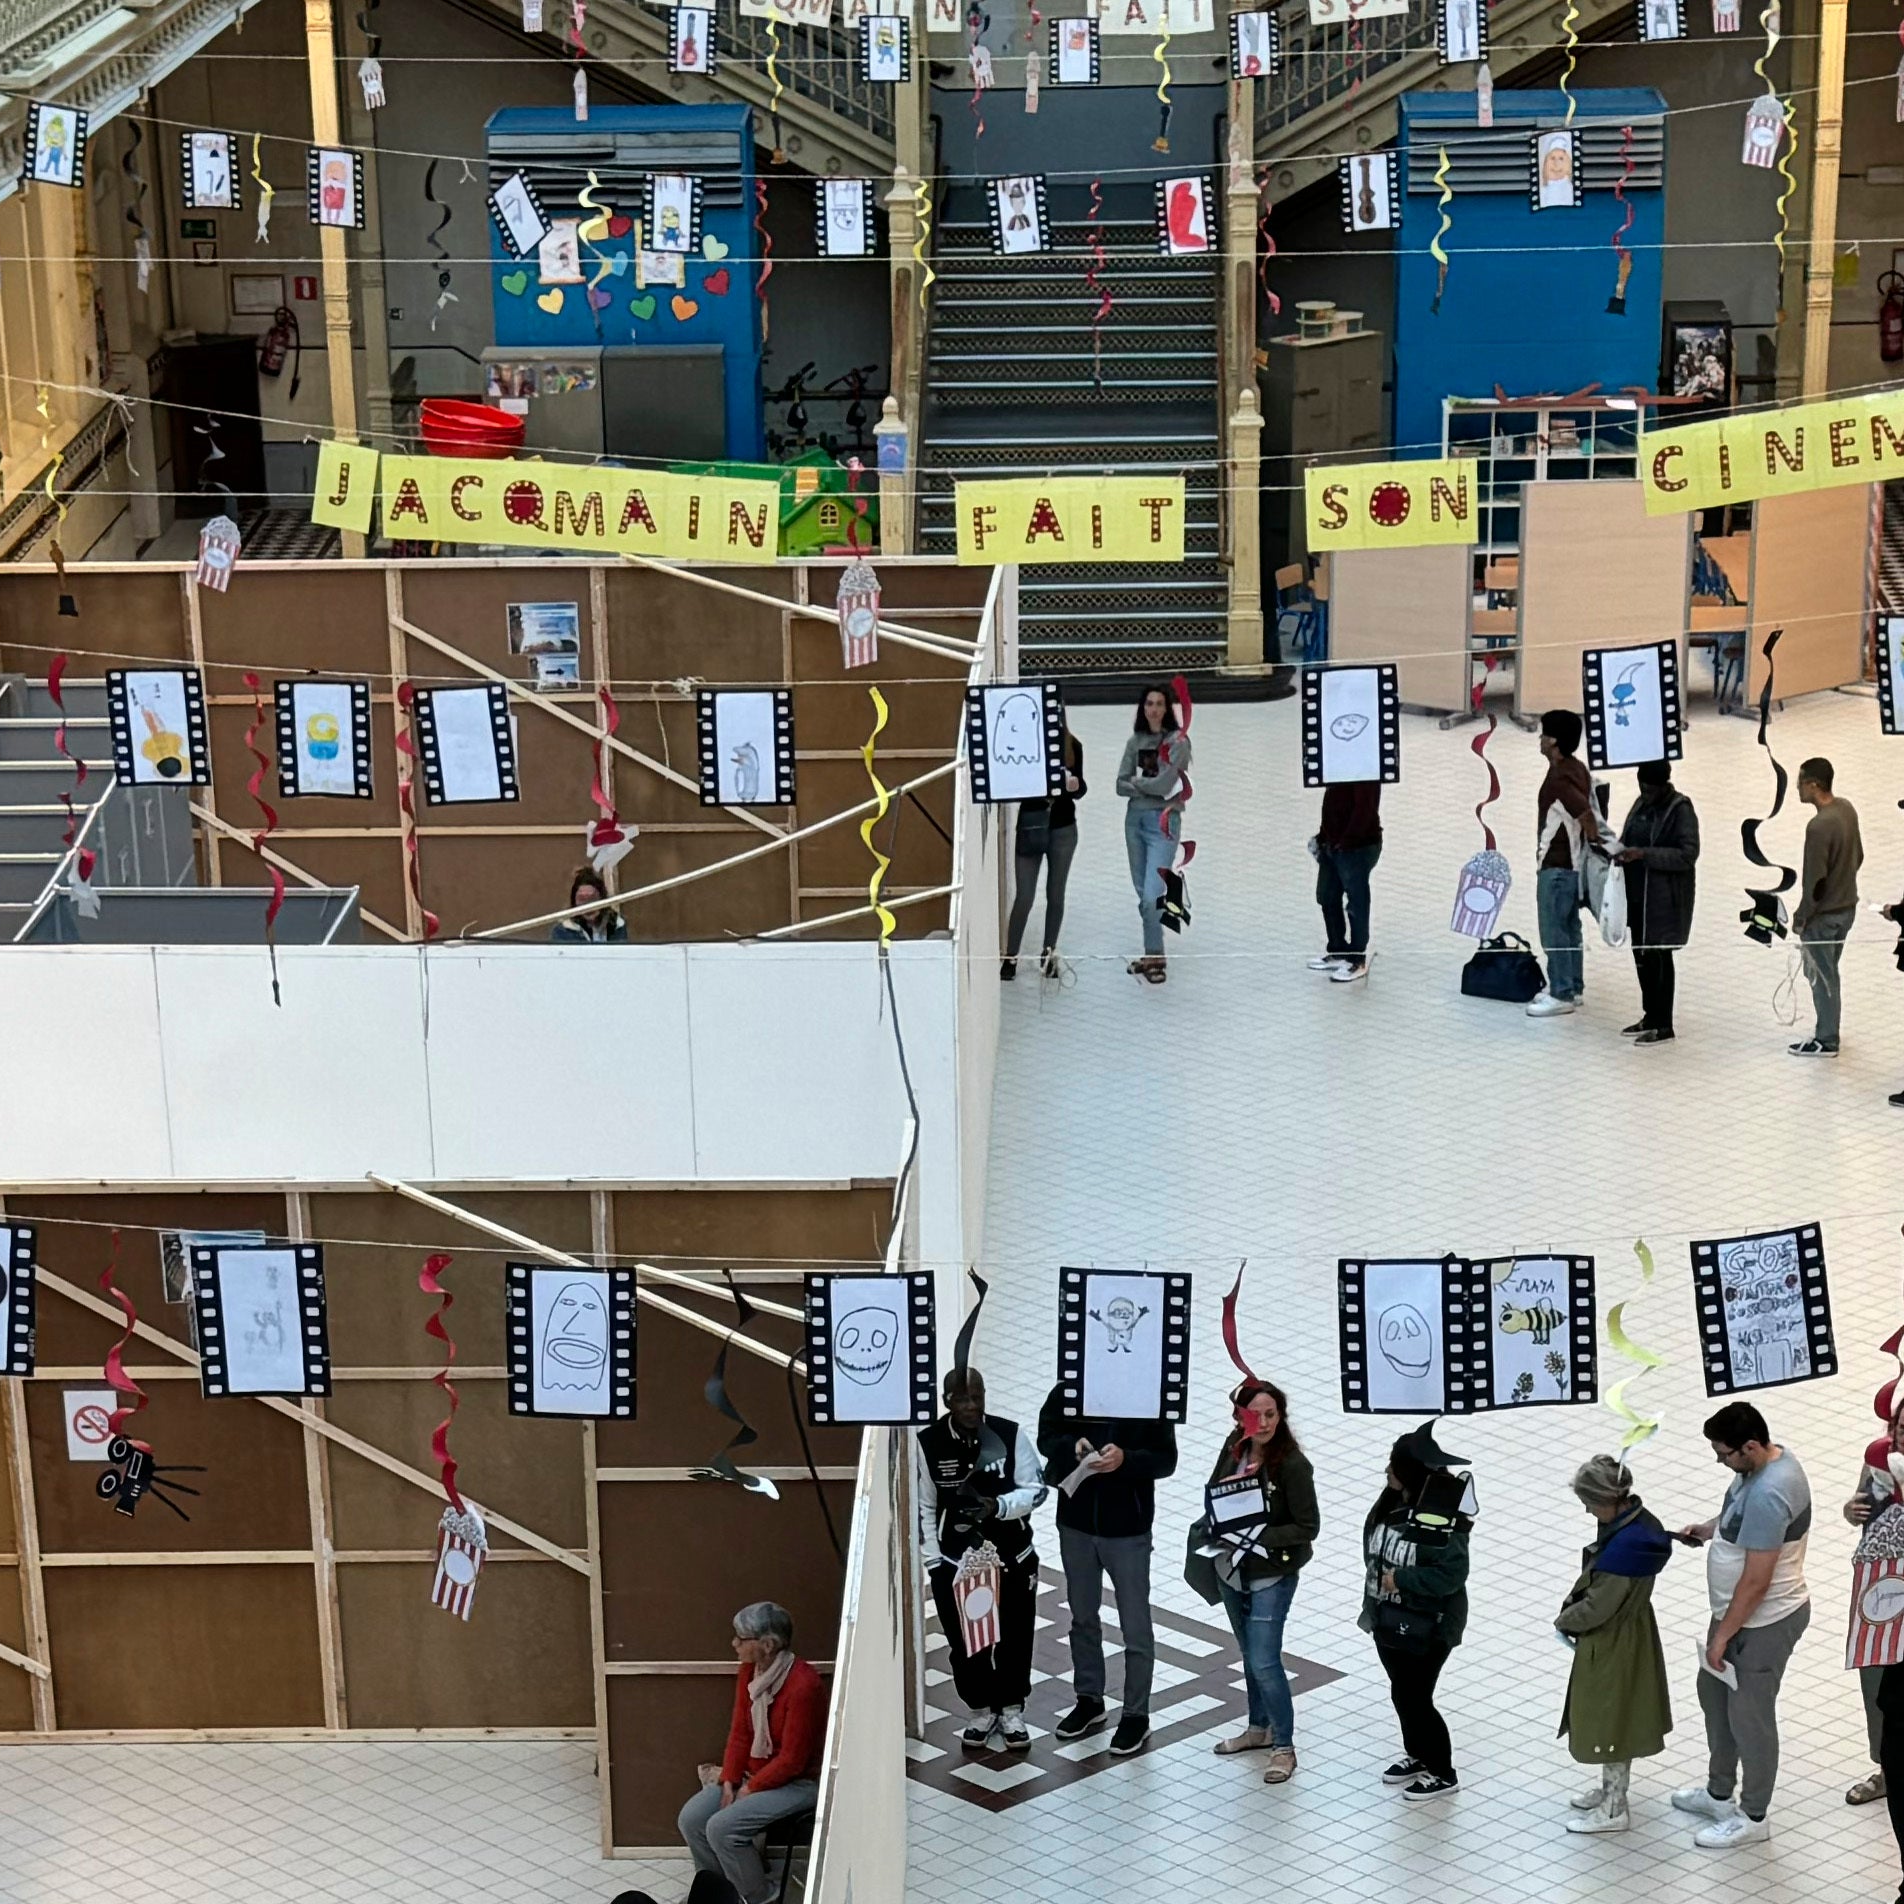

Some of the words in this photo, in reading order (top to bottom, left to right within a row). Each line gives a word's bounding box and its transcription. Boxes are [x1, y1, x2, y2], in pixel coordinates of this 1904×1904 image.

[328, 461, 768, 548] JACQMAIN
[971, 497, 1171, 549] FAIT
[1317, 474, 1469, 530] SON
